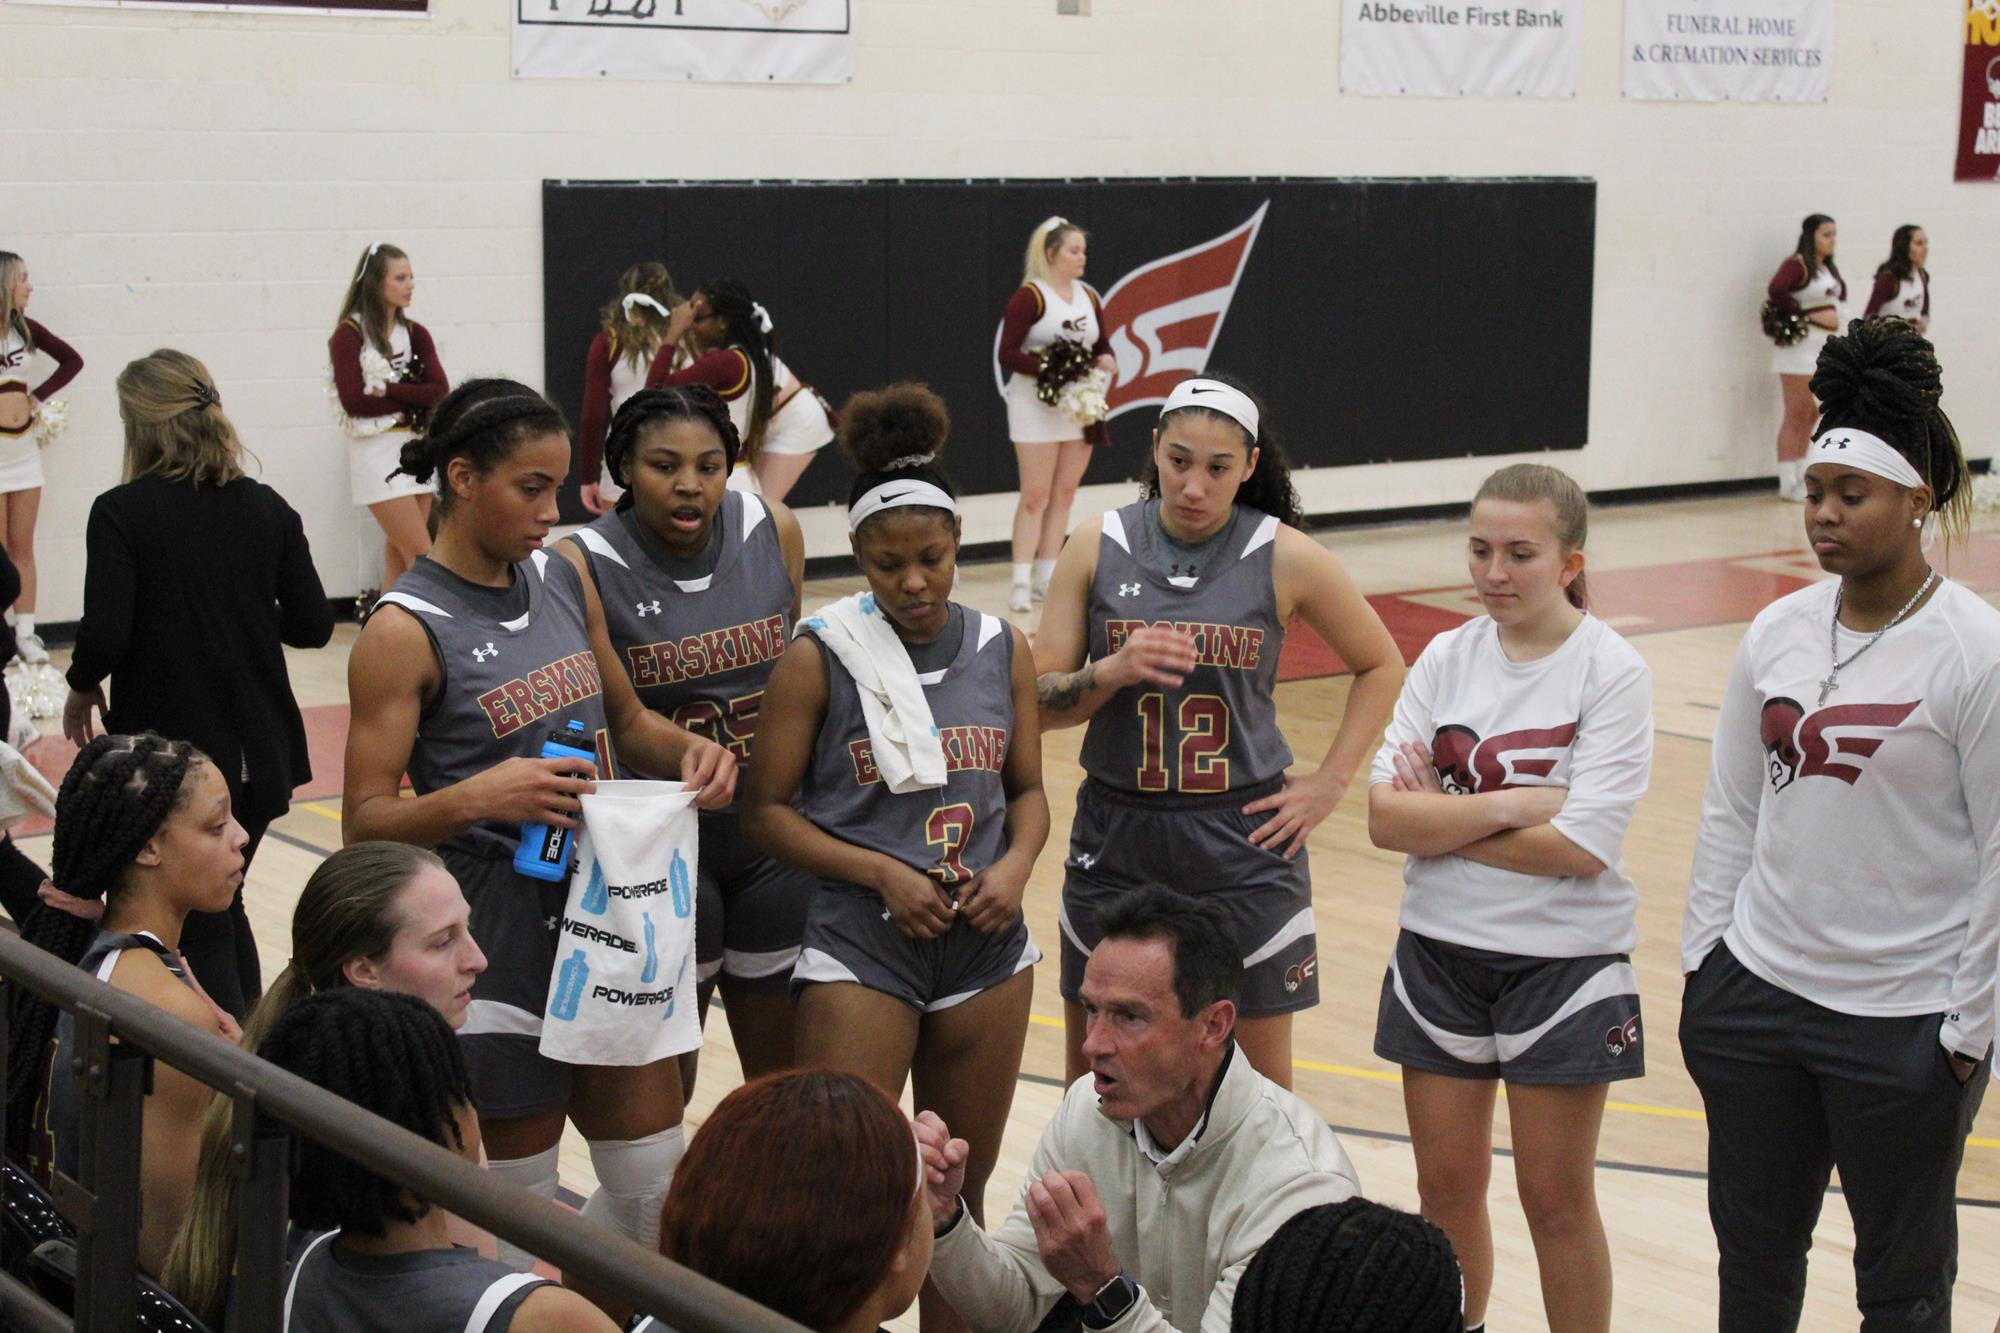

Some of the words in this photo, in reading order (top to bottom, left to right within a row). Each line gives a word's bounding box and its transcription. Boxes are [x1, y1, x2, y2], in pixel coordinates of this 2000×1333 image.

[1358, 3, 1459, 25] Abbeville
[1466, 7, 1510, 27] First
[1516, 9, 1564, 28] Bank
[1667, 14, 1744, 35] FUNERAL
[1748, 18, 1796, 37] HOME
[1632, 45, 1645, 62] &
[1649, 43, 1747, 66] CREMATION
[1752, 48, 1822, 68] SERVICES
[1974, 127, 2000, 155] AR
[627, 614, 785, 688] ERSKINE
[1105, 620, 1265, 670] EINE
[848, 725, 1007, 786] EKINE
[1137, 693, 1230, 793] 12
[608, 878, 669, 900] POWERADE
[561, 917, 639, 955] WERADE.
[592, 985, 674, 1006] POWERADE
